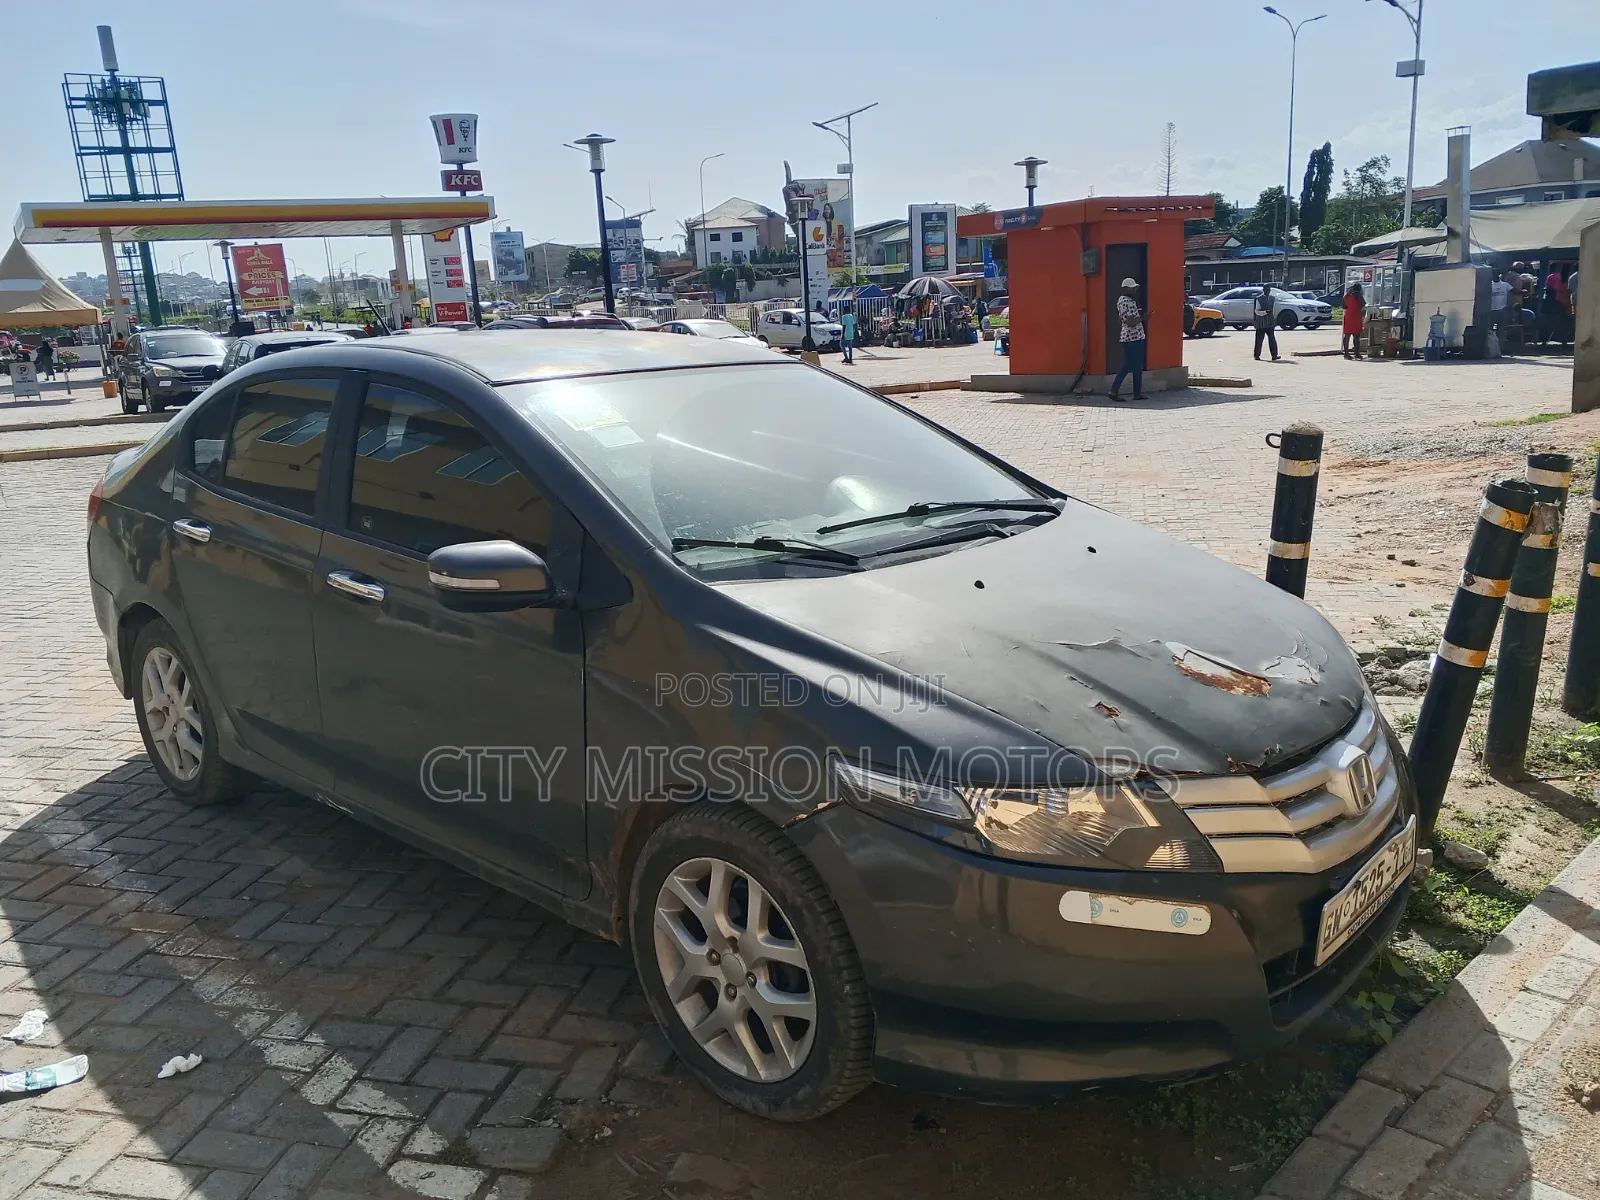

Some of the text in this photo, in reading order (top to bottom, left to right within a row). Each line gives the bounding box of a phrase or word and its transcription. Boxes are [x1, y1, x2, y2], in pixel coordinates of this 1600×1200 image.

[450, 174, 479, 186] KFC
[247, 271, 276, 280] PRICES
[1323, 905, 1344, 944] GW
[1347, 910, 1370, 938] SHOWERS
